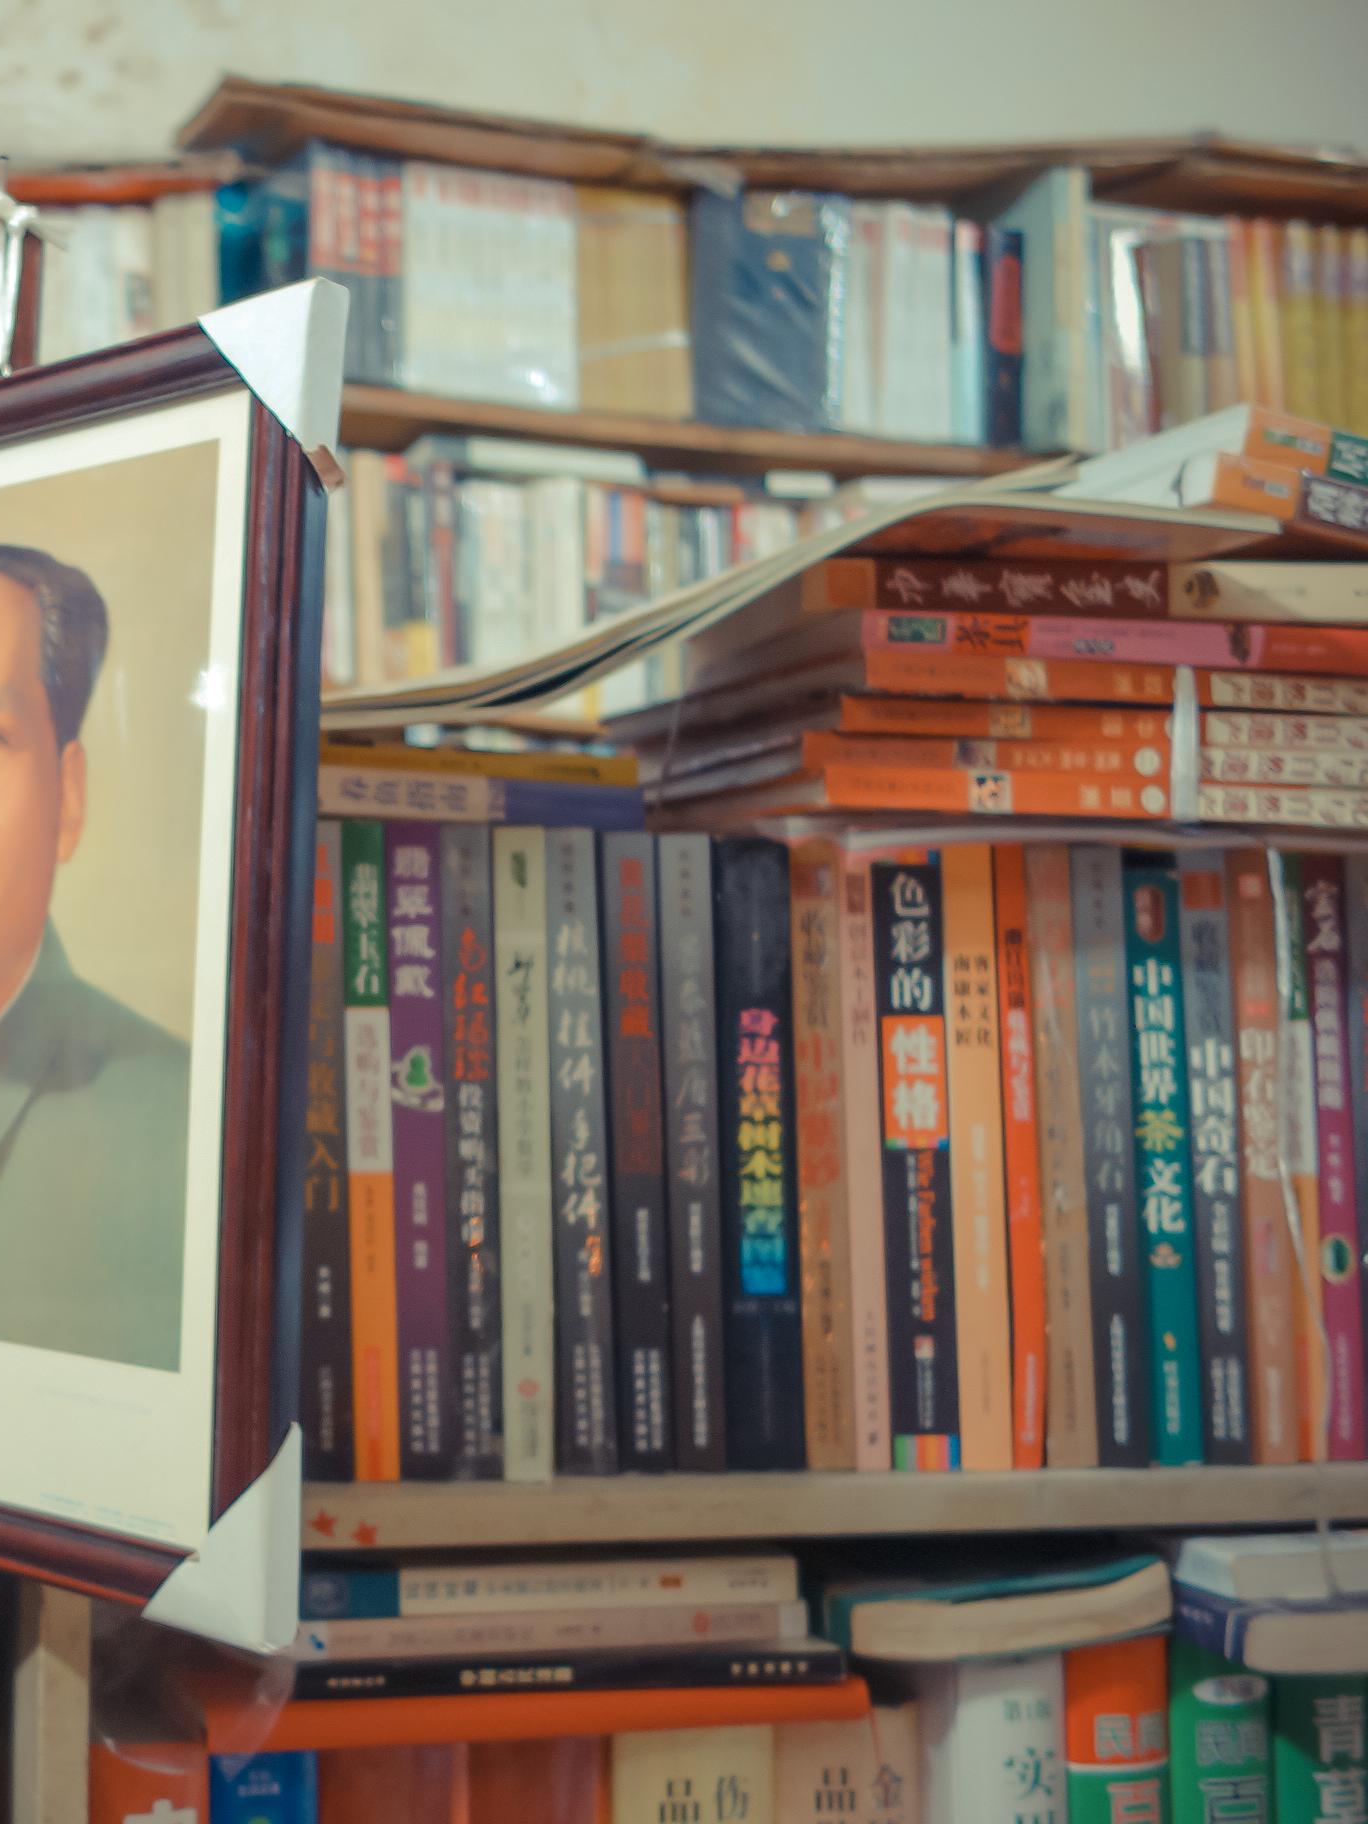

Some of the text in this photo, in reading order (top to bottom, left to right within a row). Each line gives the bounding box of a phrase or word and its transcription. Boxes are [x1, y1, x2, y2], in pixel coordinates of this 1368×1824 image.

[887, 872, 942, 1132] 色彩的性格
[1131, 958, 1186, 1234] 中国世界茶文化
[1190, 1037, 1238, 1196] 中国奇石
